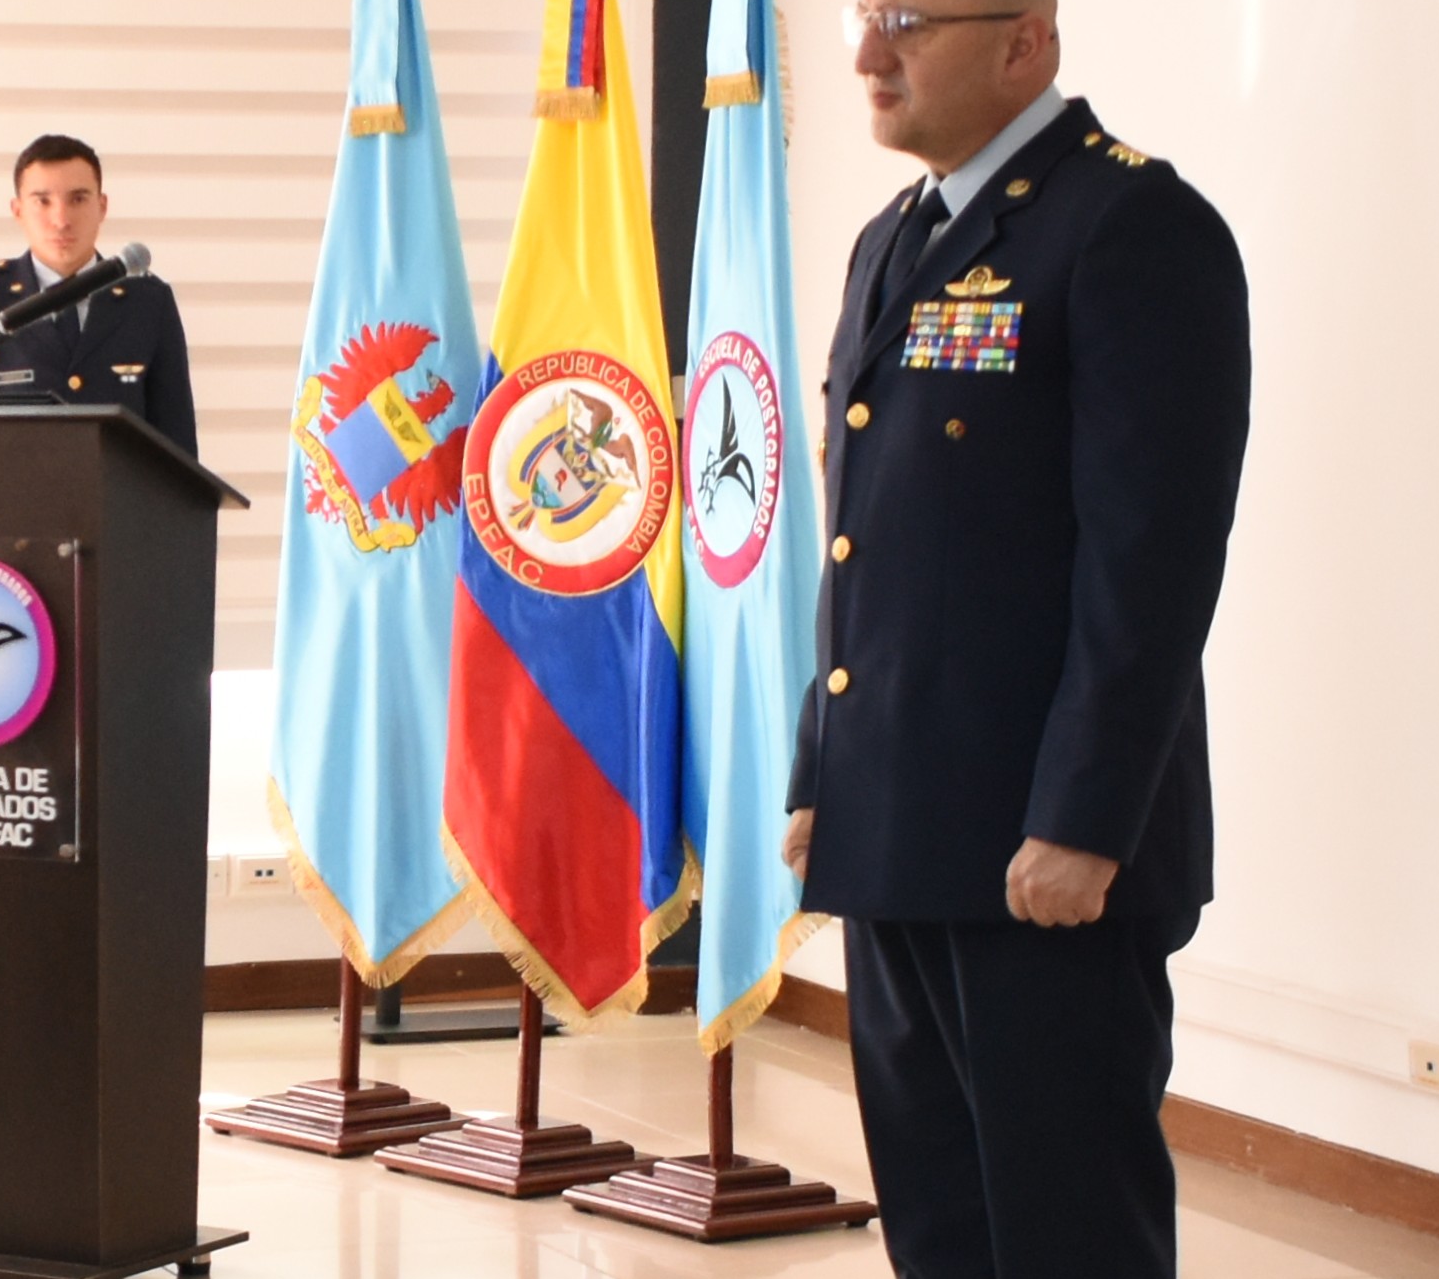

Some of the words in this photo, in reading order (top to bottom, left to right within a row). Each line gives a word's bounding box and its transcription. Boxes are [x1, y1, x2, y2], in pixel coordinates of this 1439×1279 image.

[517, 351, 630, 397] REPÚBLICA
[630, 392, 656, 425] DE
[699, 335, 742, 379] ESCUELA
[742, 348, 760, 379] DE
[753, 374, 778, 540] POSTGRADOS
[627, 426, 668, 554] COLOMBIA
[340, 498, 365, 537] ASTRA
[465, 473, 544, 585] EPFAC
[15, 767, 49, 793] DE
